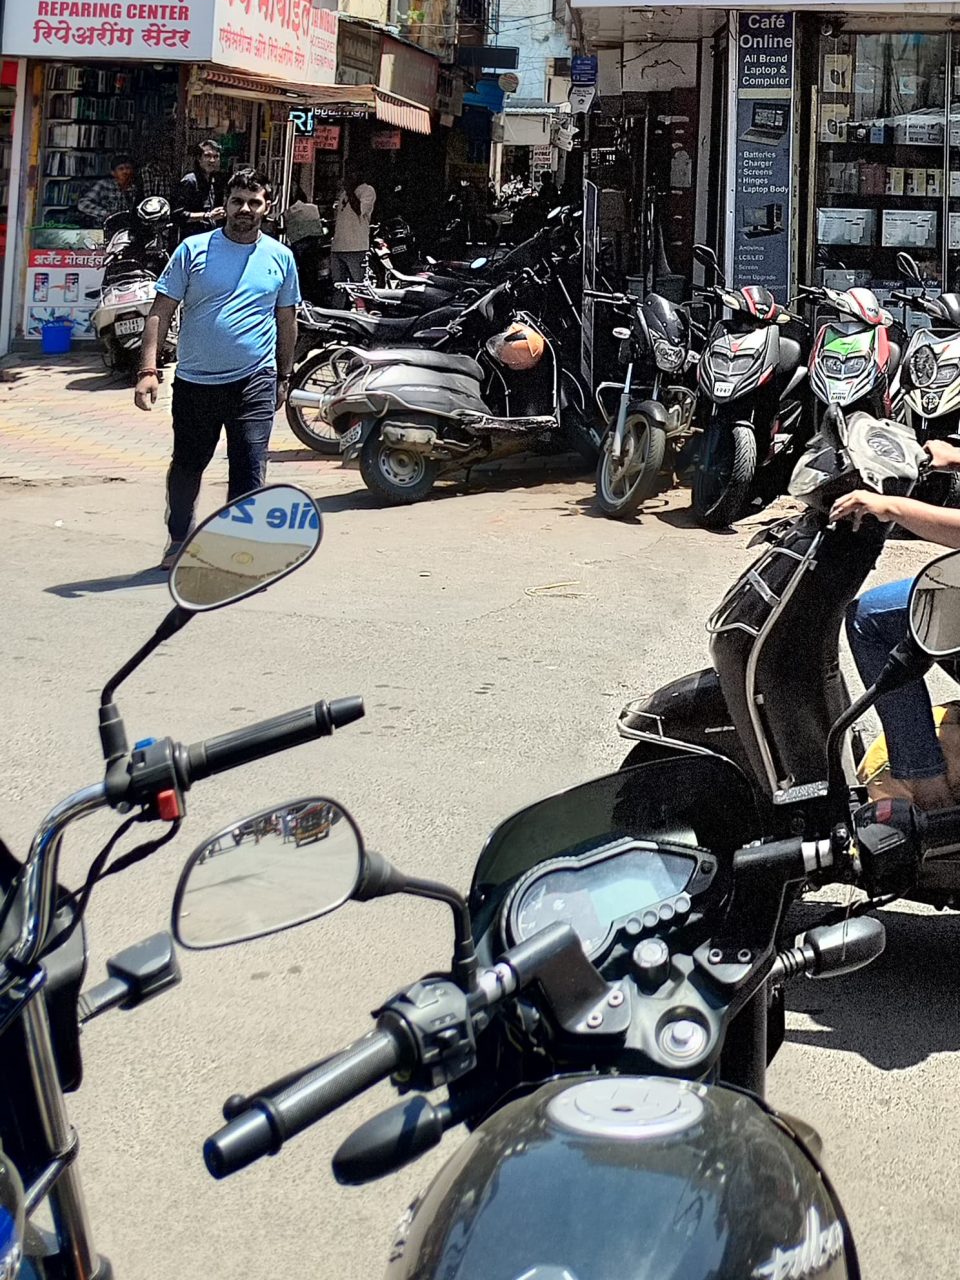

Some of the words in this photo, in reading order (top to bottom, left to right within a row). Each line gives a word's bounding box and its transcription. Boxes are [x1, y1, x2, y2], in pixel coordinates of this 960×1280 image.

[38, 1, 122, 19] REPARING
[127, 4, 190, 20] CENTER
[748, 14, 785, 29] Café
[142, 23, 191, 48] सेंटर
[740, 34, 793, 48] Online
[744, 54, 758, 63] All
[760, 54, 788, 63] Brand
[744, 65, 778, 75] Laptop
[779, 65, 787, 74] &
[742, 76, 790, 86] Computer
[743, 160, 773, 168] Charger
[743, 168, 773, 176] Screens
[742, 177, 768, 185] Hinges
[742, 186, 768, 194] Laptop
[769, 186, 789, 194] Body
